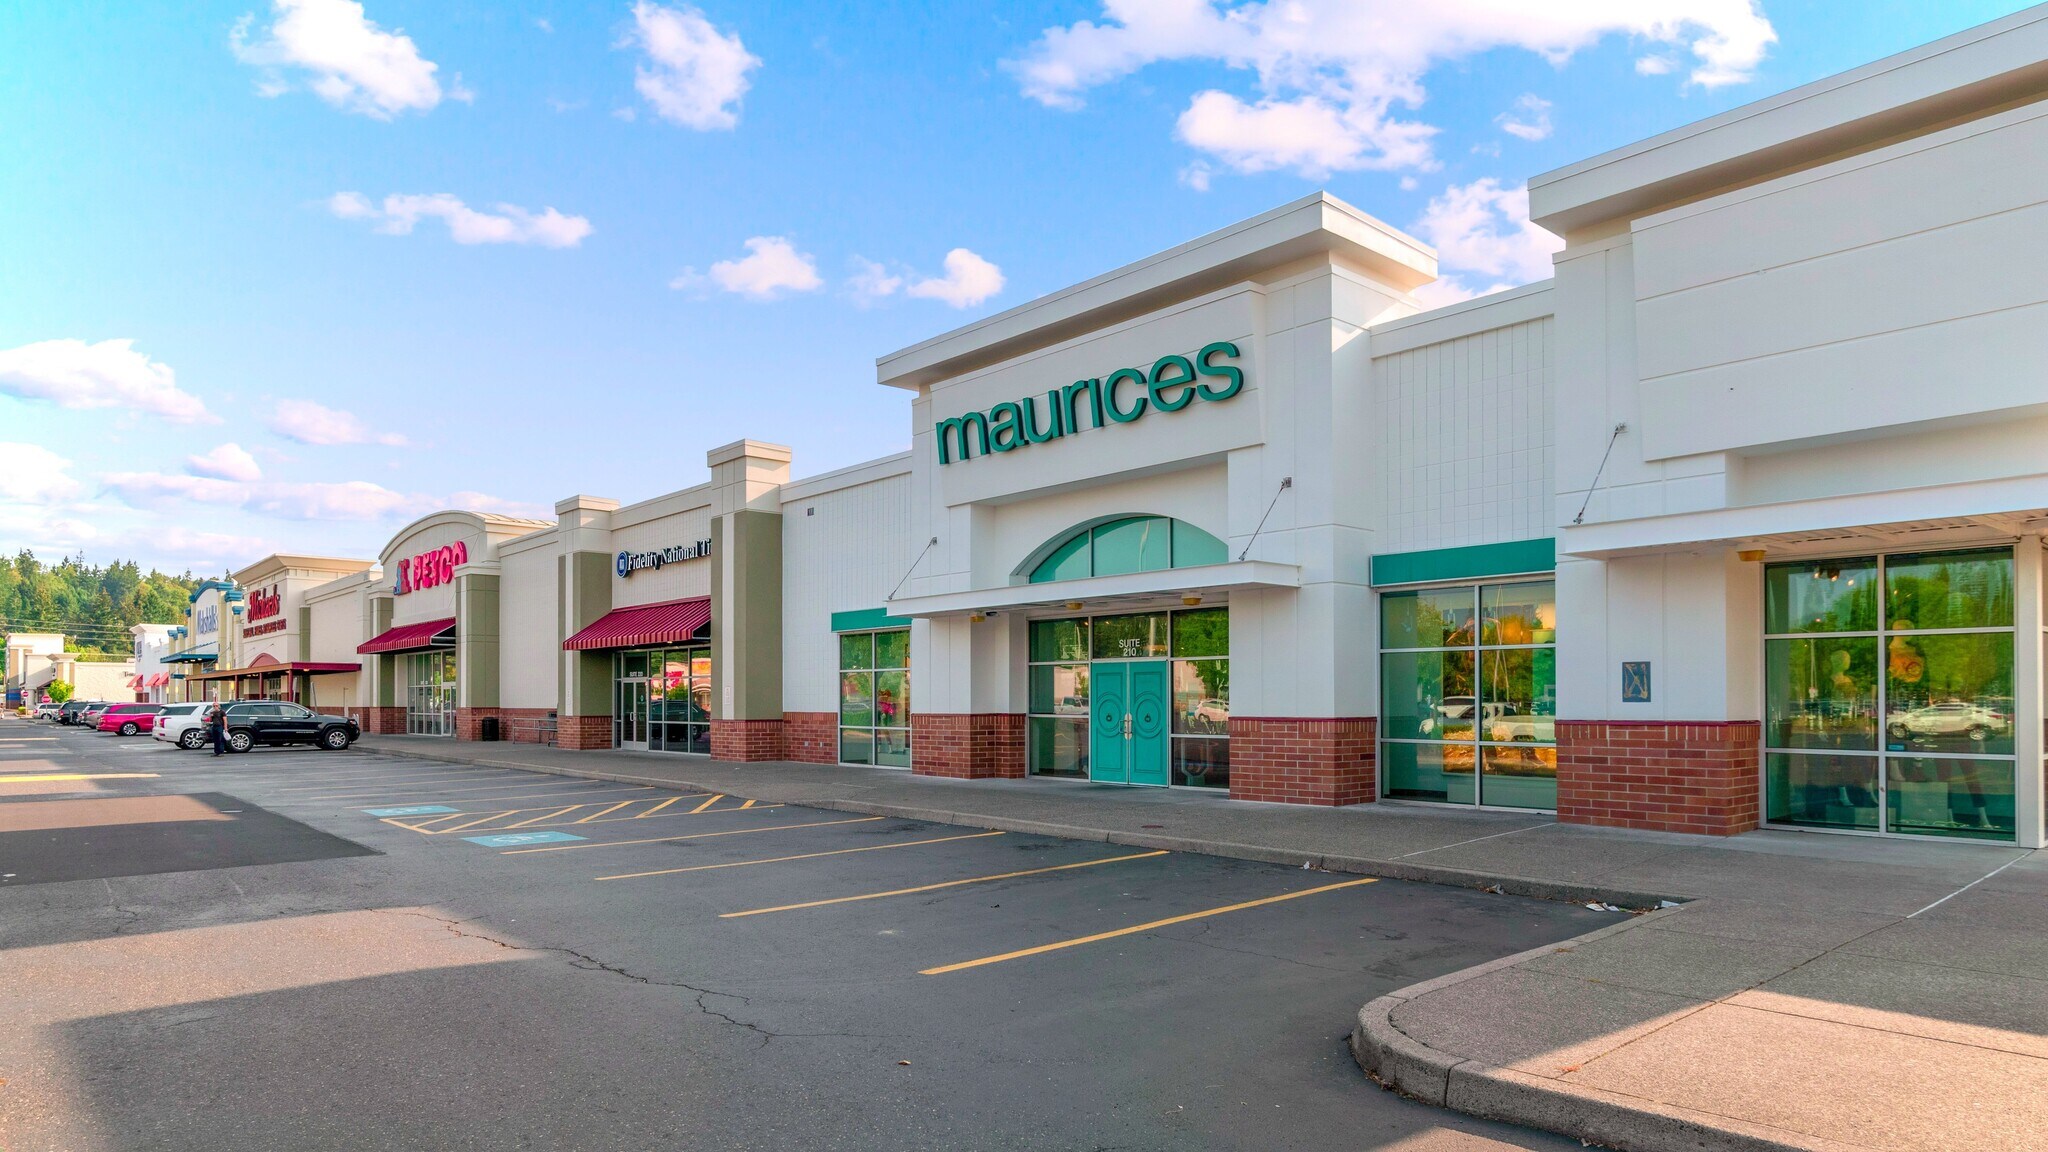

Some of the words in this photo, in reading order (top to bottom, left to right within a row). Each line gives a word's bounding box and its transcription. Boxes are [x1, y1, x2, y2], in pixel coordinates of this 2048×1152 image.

[936, 341, 1244, 465] maurices
[413, 540, 467, 591] PETCO
[628, 550, 660, 571] Fidelity
[660, 540, 699, 565] National
[699, 537, 711, 557] Ti
[1118, 638, 1140, 648] SUITE
[1123, 647, 1137, 657] 210
